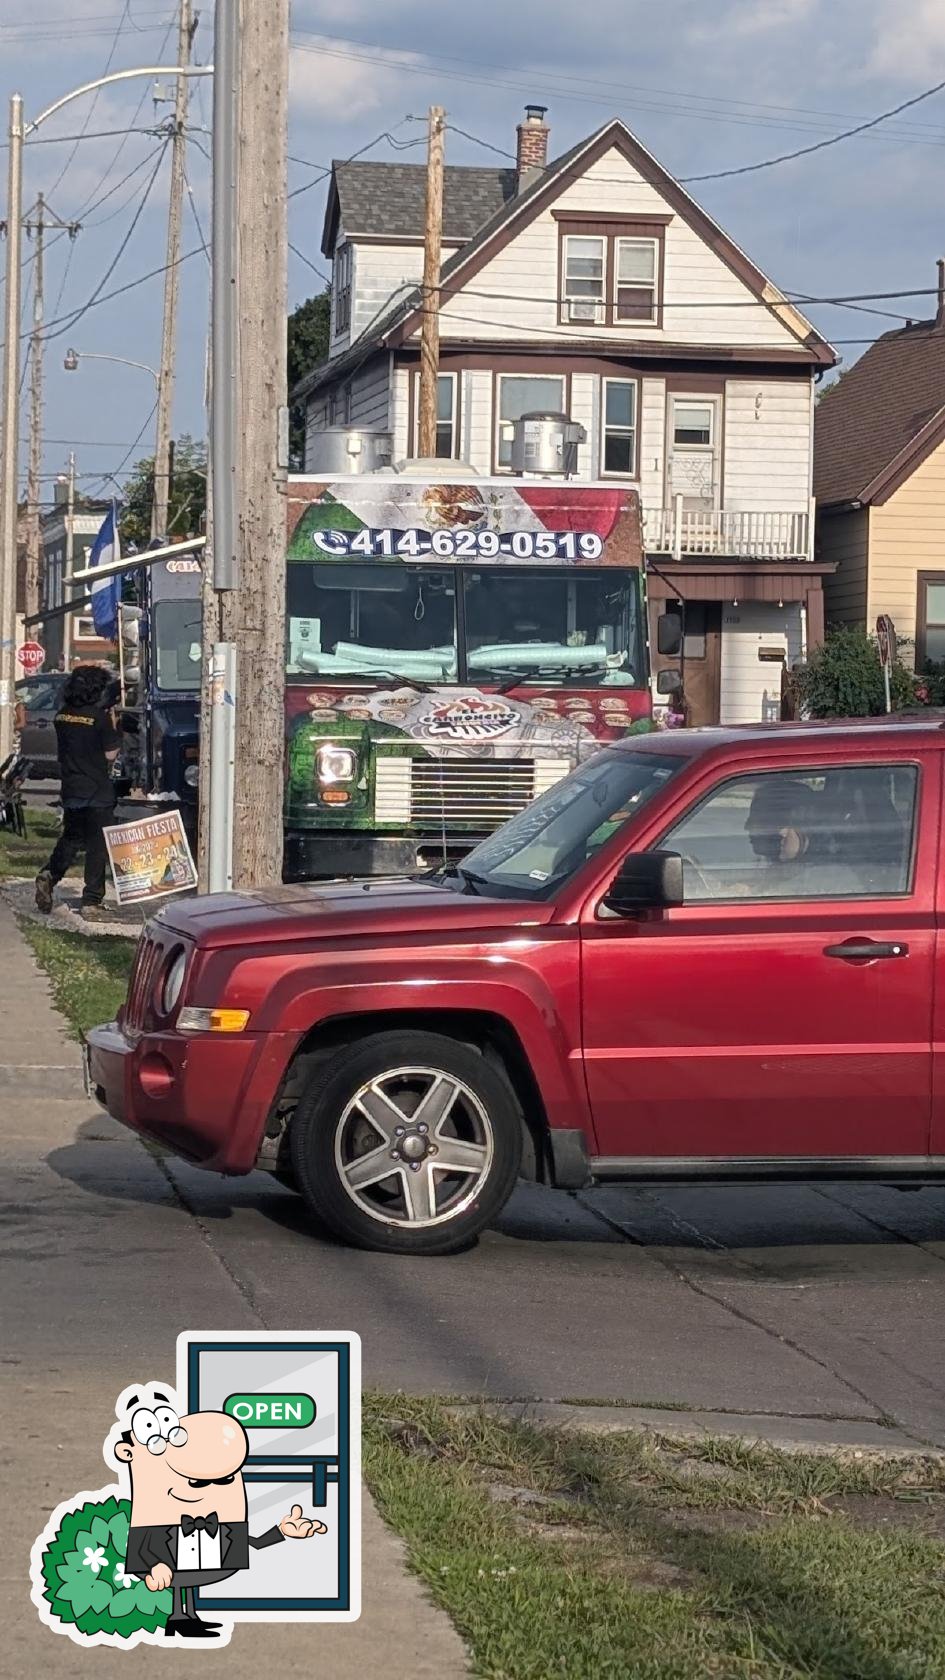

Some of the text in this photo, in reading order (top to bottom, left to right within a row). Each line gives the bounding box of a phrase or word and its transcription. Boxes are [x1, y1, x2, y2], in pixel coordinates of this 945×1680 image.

[351, 529, 603, 558] 414-629-0519
[17, 650, 43, 661] STOP
[109, 818, 178, 846] MEXICAN FIESTA
[140, 853, 154, 868] 23
